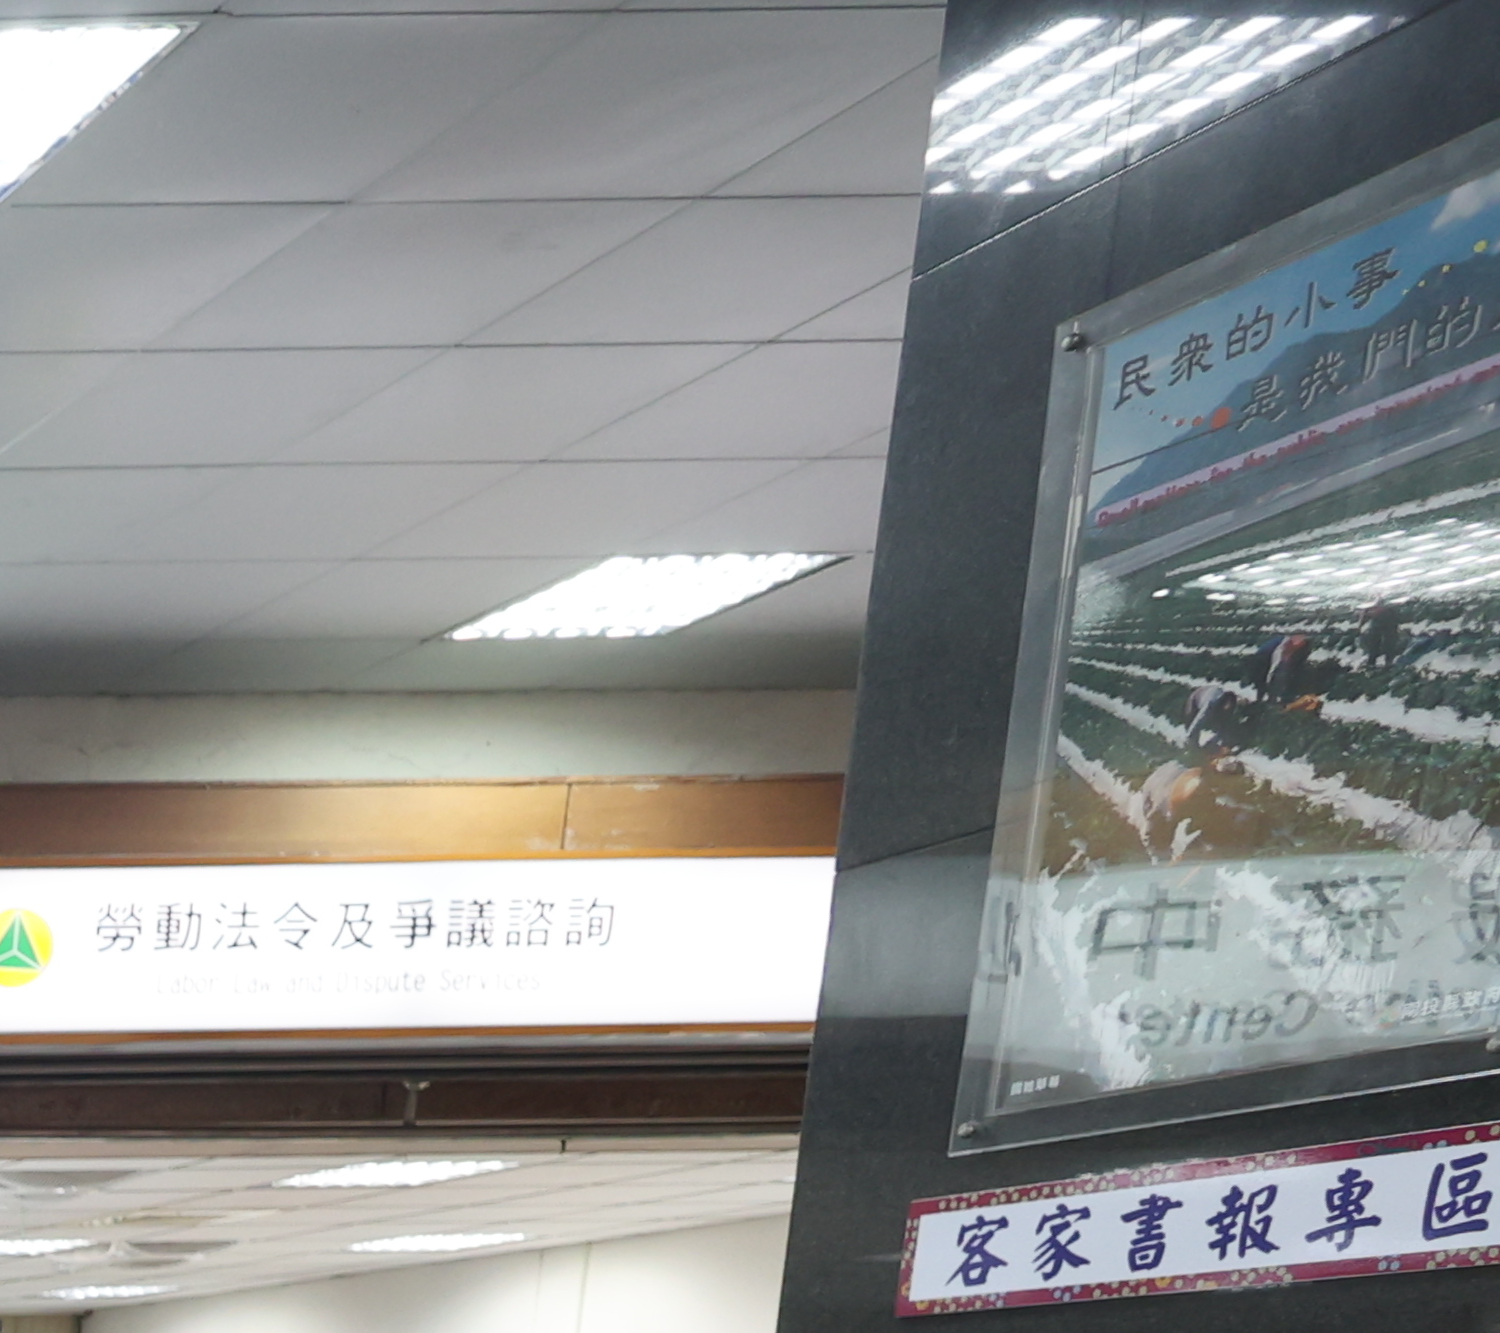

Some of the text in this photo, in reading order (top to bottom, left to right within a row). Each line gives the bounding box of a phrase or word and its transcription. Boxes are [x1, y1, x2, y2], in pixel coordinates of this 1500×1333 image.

[96, 898, 615, 952] 勞動法令及爭議諮詢
[946, 1153, 1494, 1287] 客家書報專區
